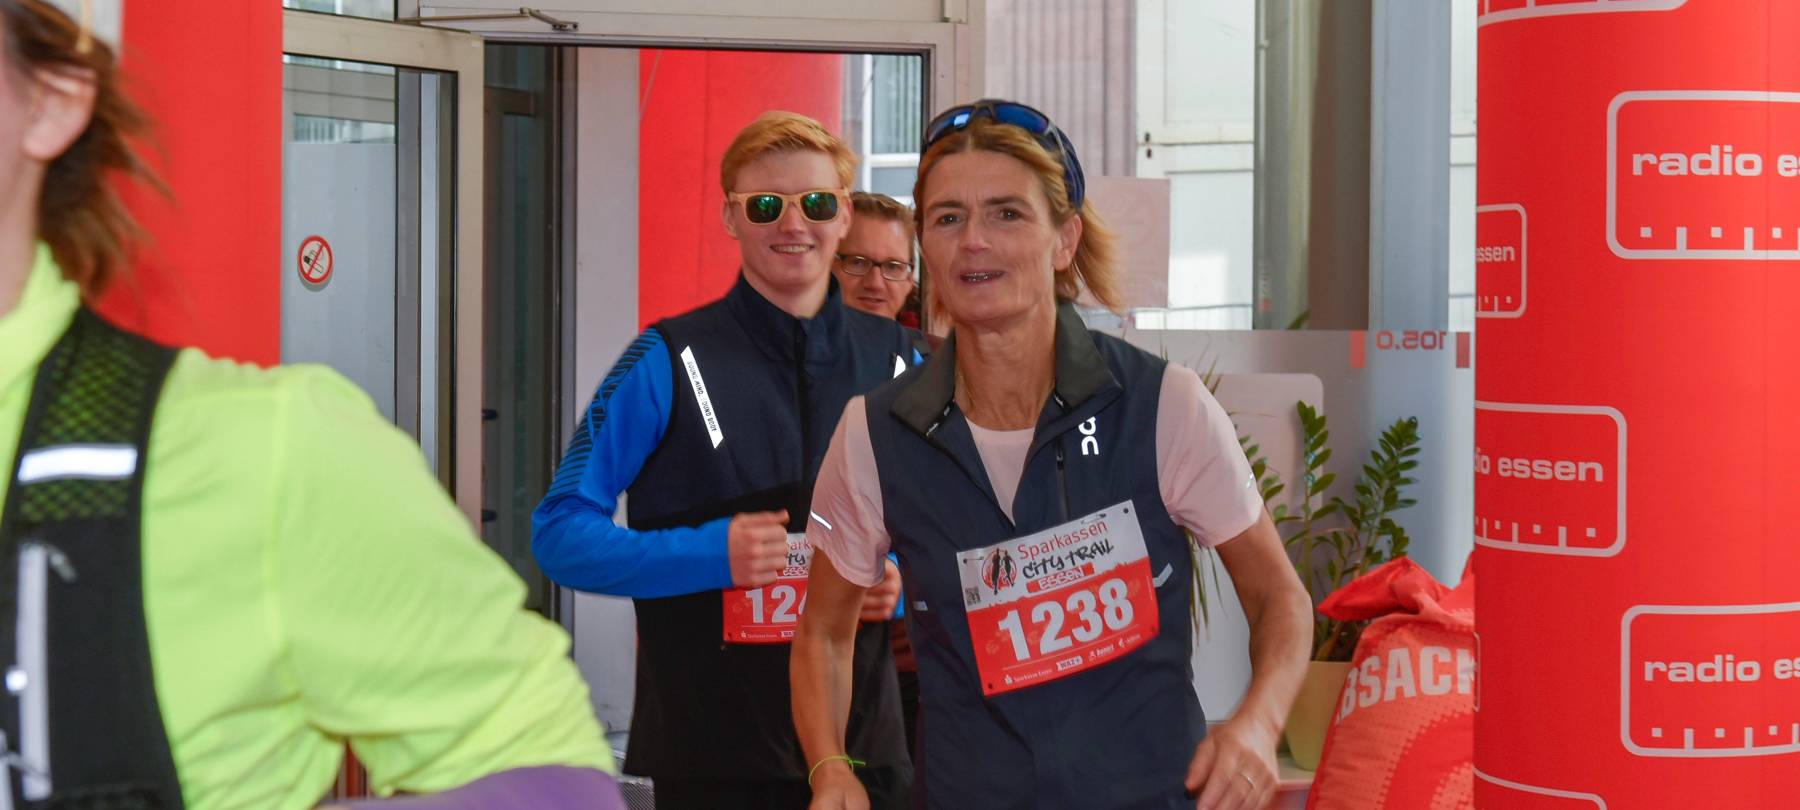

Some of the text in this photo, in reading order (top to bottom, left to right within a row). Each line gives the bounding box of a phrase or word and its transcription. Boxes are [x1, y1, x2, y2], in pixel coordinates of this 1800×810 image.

[1632, 144, 1763, 176] radio
[1498, 456, 1604, 482] essen
[1017, 519, 1109, 561] Sparkassen
[1039, 566, 1085, 591] ESSEN
[997, 577, 1134, 661] 1238
[1644, 654, 1761, 683] radio
